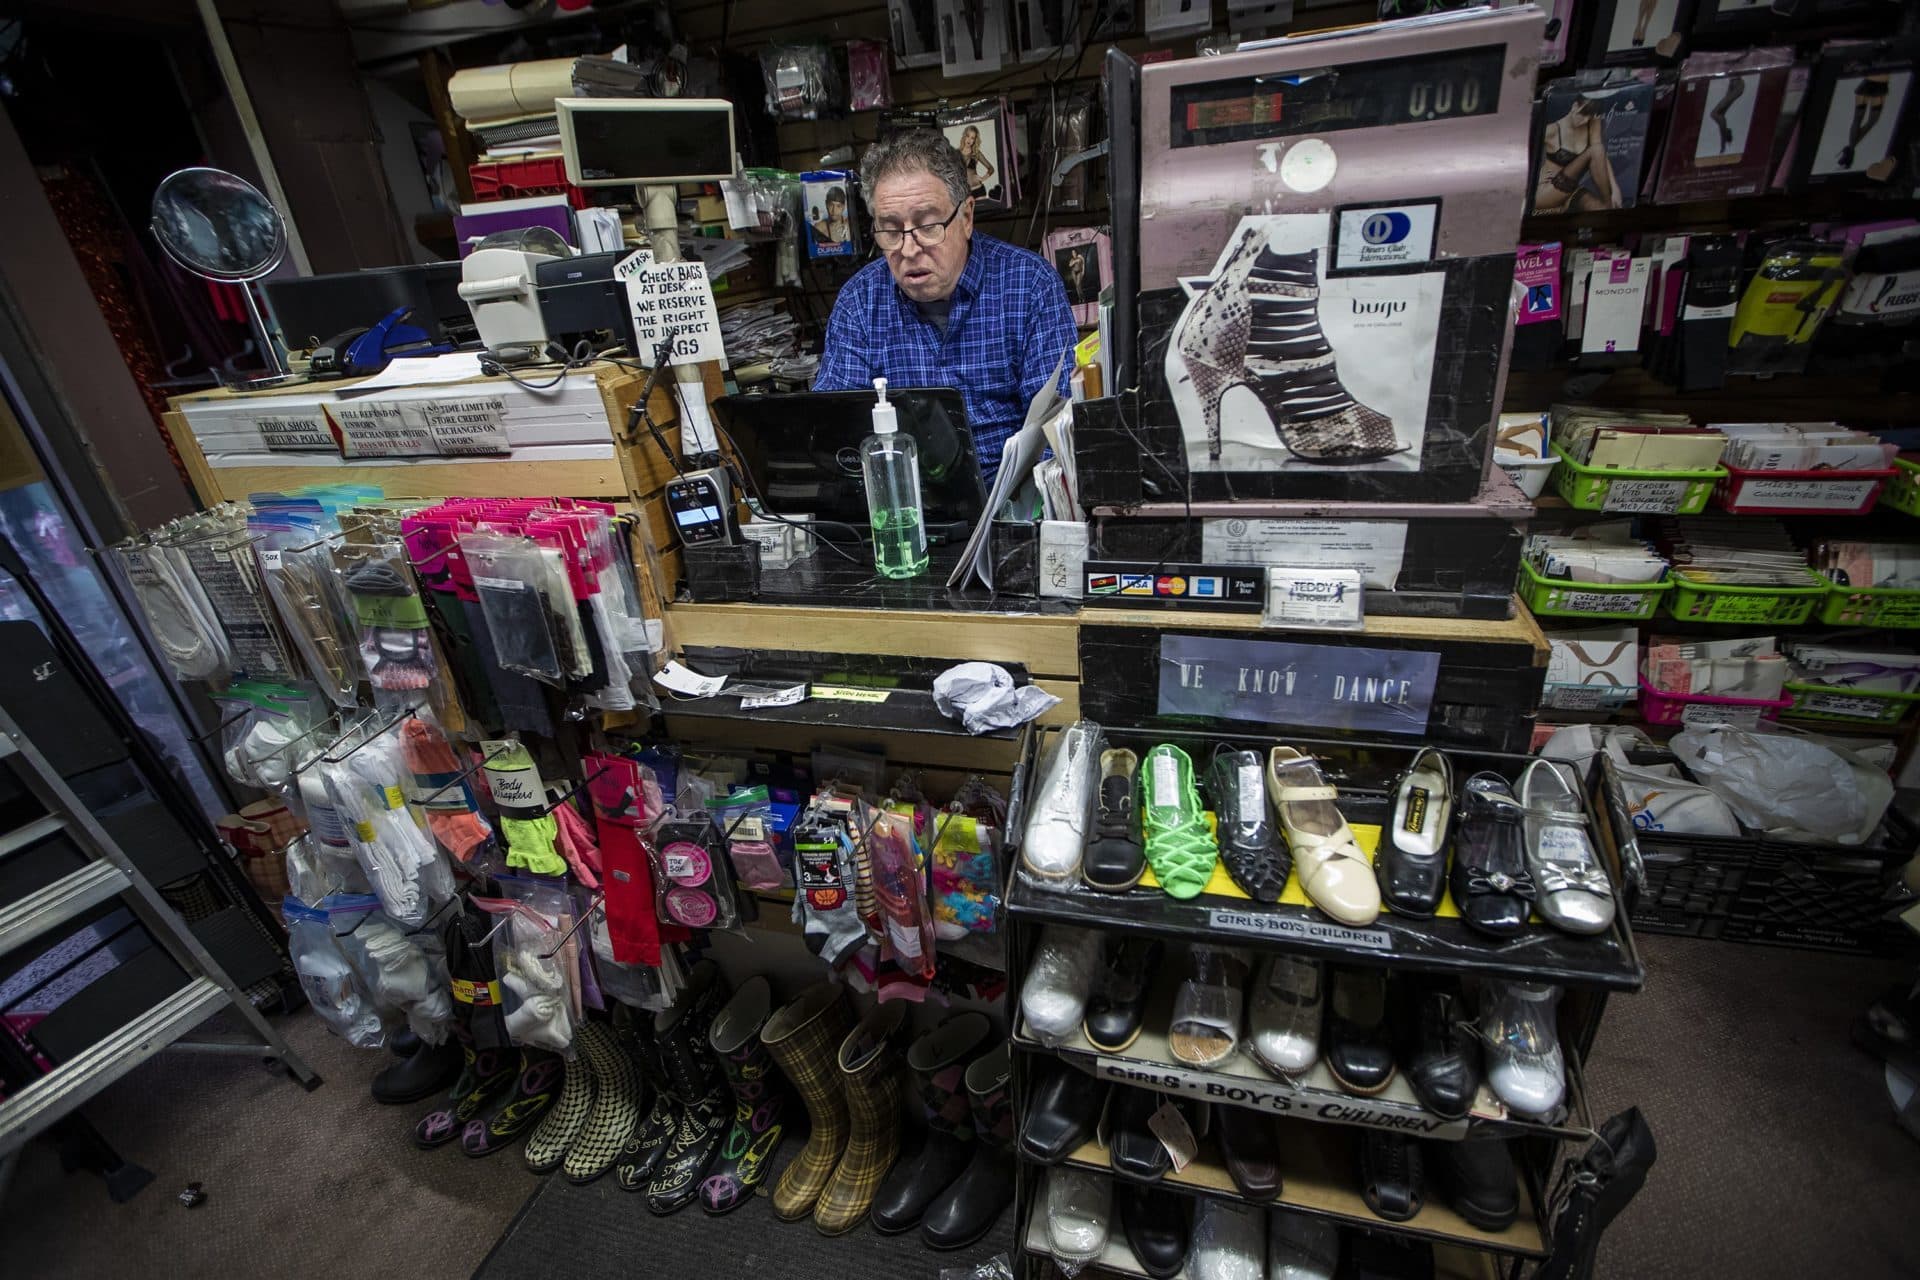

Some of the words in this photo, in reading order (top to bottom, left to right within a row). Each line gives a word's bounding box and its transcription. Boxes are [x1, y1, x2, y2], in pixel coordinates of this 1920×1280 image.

[1361, 246, 1385, 254] Diners
[1387, 245, 1406, 253] Club
[1360, 251, 1410, 262] International
[620, 251, 651, 277] PLEASE
[640, 267, 674, 284] CHECK
[678, 265, 703, 281] BAGS
[641, 284, 655, 294] AT
[659, 282, 687, 294] DESK
[1595, 287, 1639, 296] MONDOR
[637, 300, 655, 312] WE
[659, 295, 707, 310] RESERVE
[635, 316, 657, 326] THE
[663, 310, 705, 323] RIGHT
[640, 328, 655, 339] TO
[662, 322, 710, 337] INSPECT
[340, 410, 358, 418] FULL
[359, 409, 388, 418] REFUND
[389, 408, 401, 417] ON
[441, 404, 460, 413] TIME
[462, 402, 484, 411] LIMIT
[486, 401, 504, 410] FOR
[344, 420, 377, 428] UNWORN
[432, 414, 457, 424] STORE
[257, 422, 287, 432] TEDDY
[288, 420, 318, 432] SHOES
[435, 424, 481, 435] EXCHANGES
[482, 423, 496, 432] ON
[264, 434, 299, 445] RETURN
[299, 433, 334, 445] POLICY
[440, 436, 474, 445] UNWORN
[1126, 580, 1149, 590] VISA
[1234, 580, 1256, 590] Thank
[1294, 581, 1334, 593] TEDDY
[1180, 664, 1204, 689] WE
[1237, 667, 1297, 696] KNOW
[1332, 675, 1411, 705] DANCE
[496, 778, 522, 794] Body
[493, 787, 533, 801] Wrappers
[823, 836, 834, 844] 5-9
[803, 871, 811, 882] 3
[1310, 926, 1384, 945] CHILDREN
